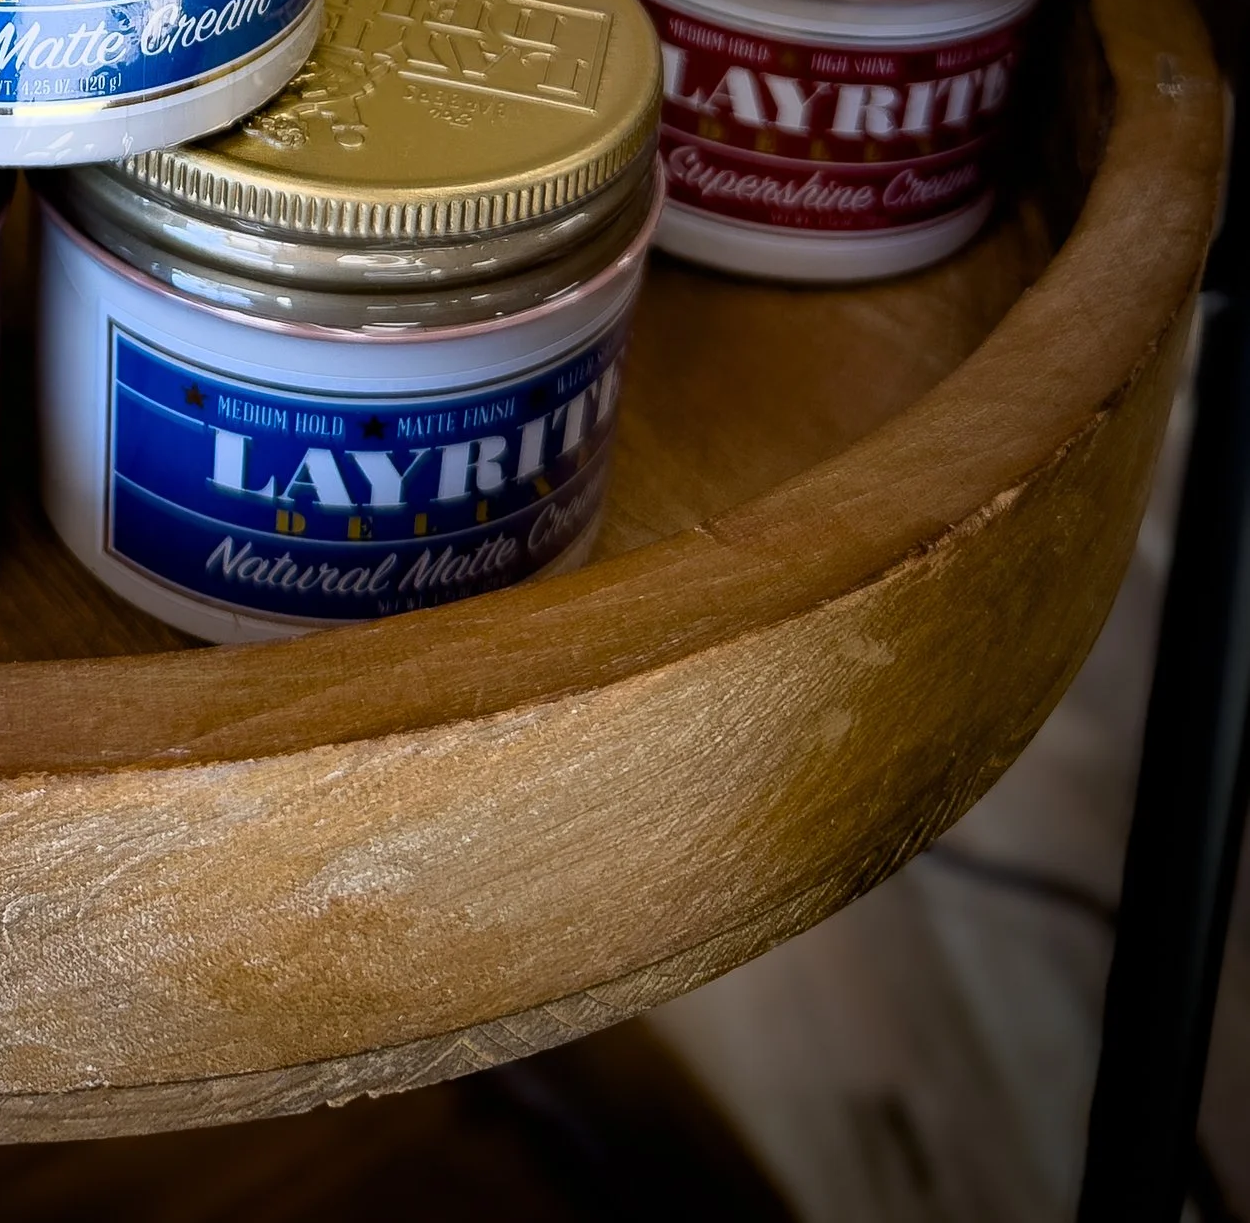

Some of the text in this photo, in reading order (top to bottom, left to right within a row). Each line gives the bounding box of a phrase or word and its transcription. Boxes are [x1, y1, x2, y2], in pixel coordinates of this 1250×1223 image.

[216, 394, 288, 432] MEDIUM
[294, 410, 344, 436] HOLD
[396, 412, 458, 439] MATTE
[462, 396, 516, 428] FINISH
[206, 535, 391, 594] Natural
[397, 530, 517, 593] Matte
